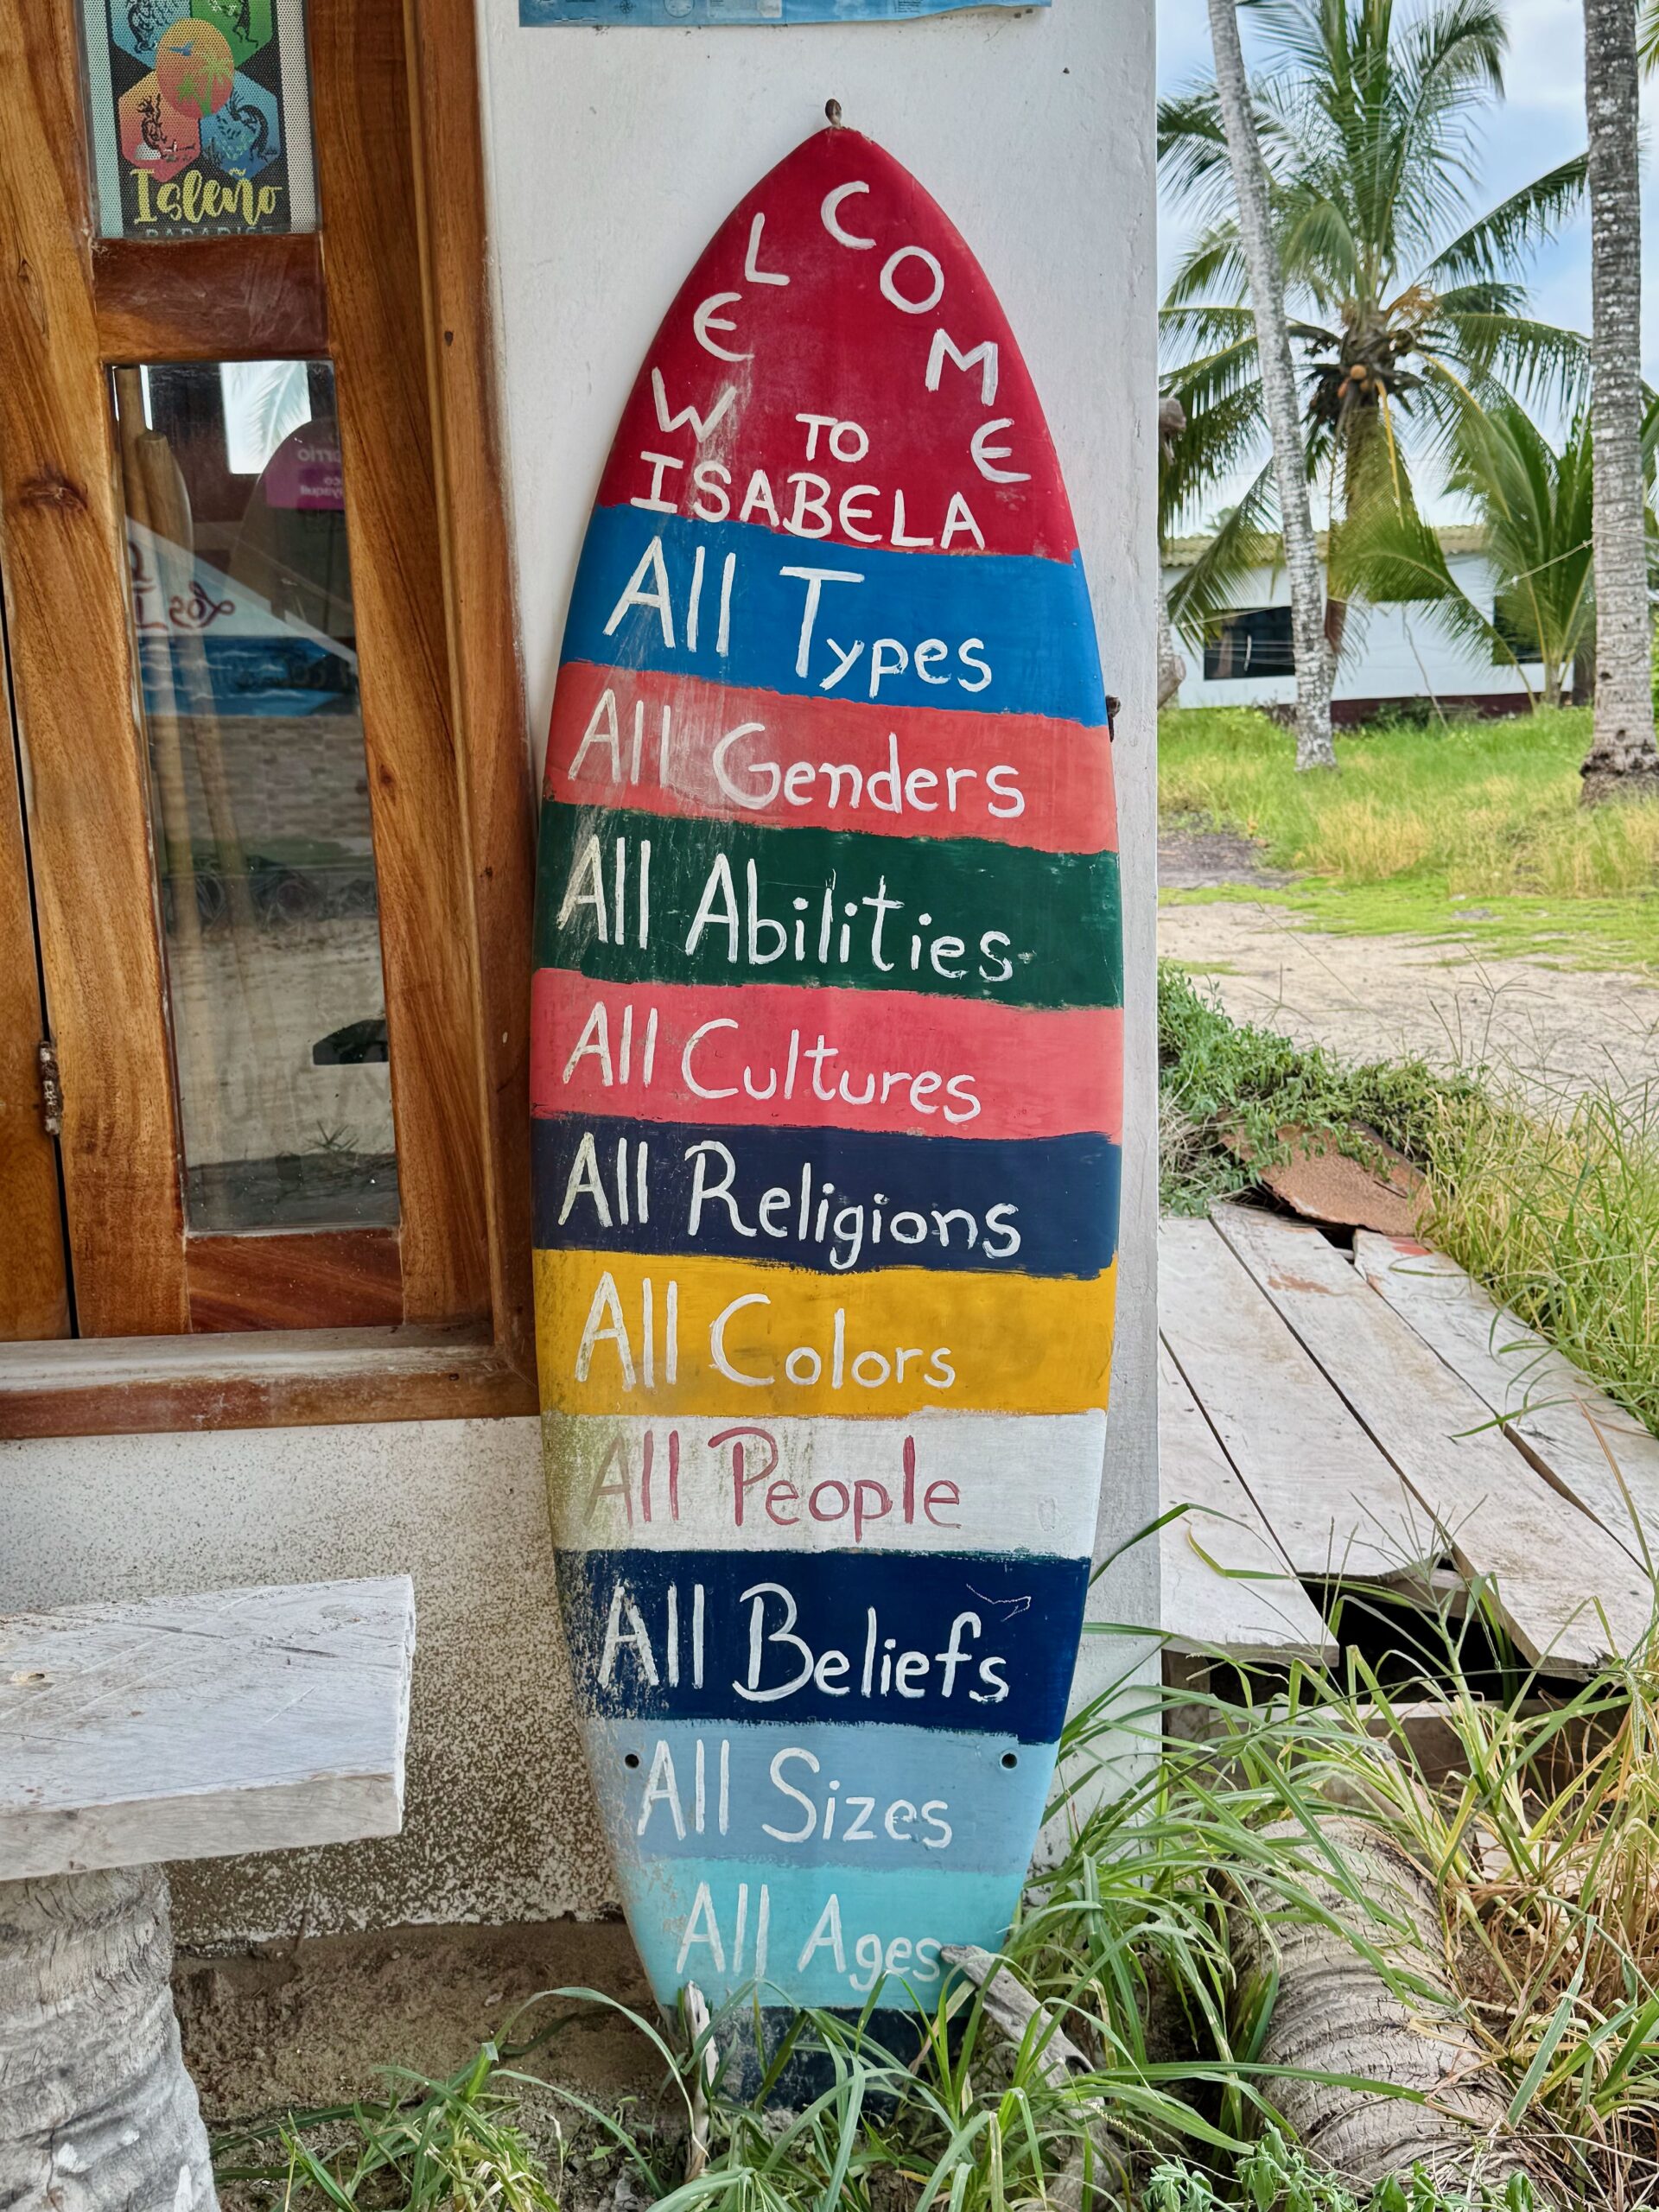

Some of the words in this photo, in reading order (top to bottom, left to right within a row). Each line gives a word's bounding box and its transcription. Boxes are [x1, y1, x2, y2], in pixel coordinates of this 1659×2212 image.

[130, 167, 283, 226] Isleño
[652, 180, 1032, 484] WELCOME
[795, 413, 869, 463] TO
[630, 450, 986, 550] ISABELA
[602, 535, 737, 657] All
[779, 566, 992, 698] Types
[568, 688, 671, 789] All
[712, 722, 1026, 818] Genders
[556, 834, 651, 950] All
[685, 852, 1013, 982] Abilities
[563, 1001, 658, 1088] All
[681, 1017, 982, 1123] Cultures
[558, 1131, 648, 1228] All
[683, 1140, 1021, 1270] Religions
[575, 1271, 678, 1392] All
[709, 1293, 957, 1389] Colors
[581, 1429, 680, 1533] All
[707, 1425, 962, 1544] People
[597, 1582, 703, 1690] All
[732, 1582, 1010, 1704] Beliefs
[637, 1738, 729, 1841] All
[761, 1746, 952, 1849] Sizes
[676, 1881, 769, 1979] All
[798, 1893, 942, 1992] Ages
